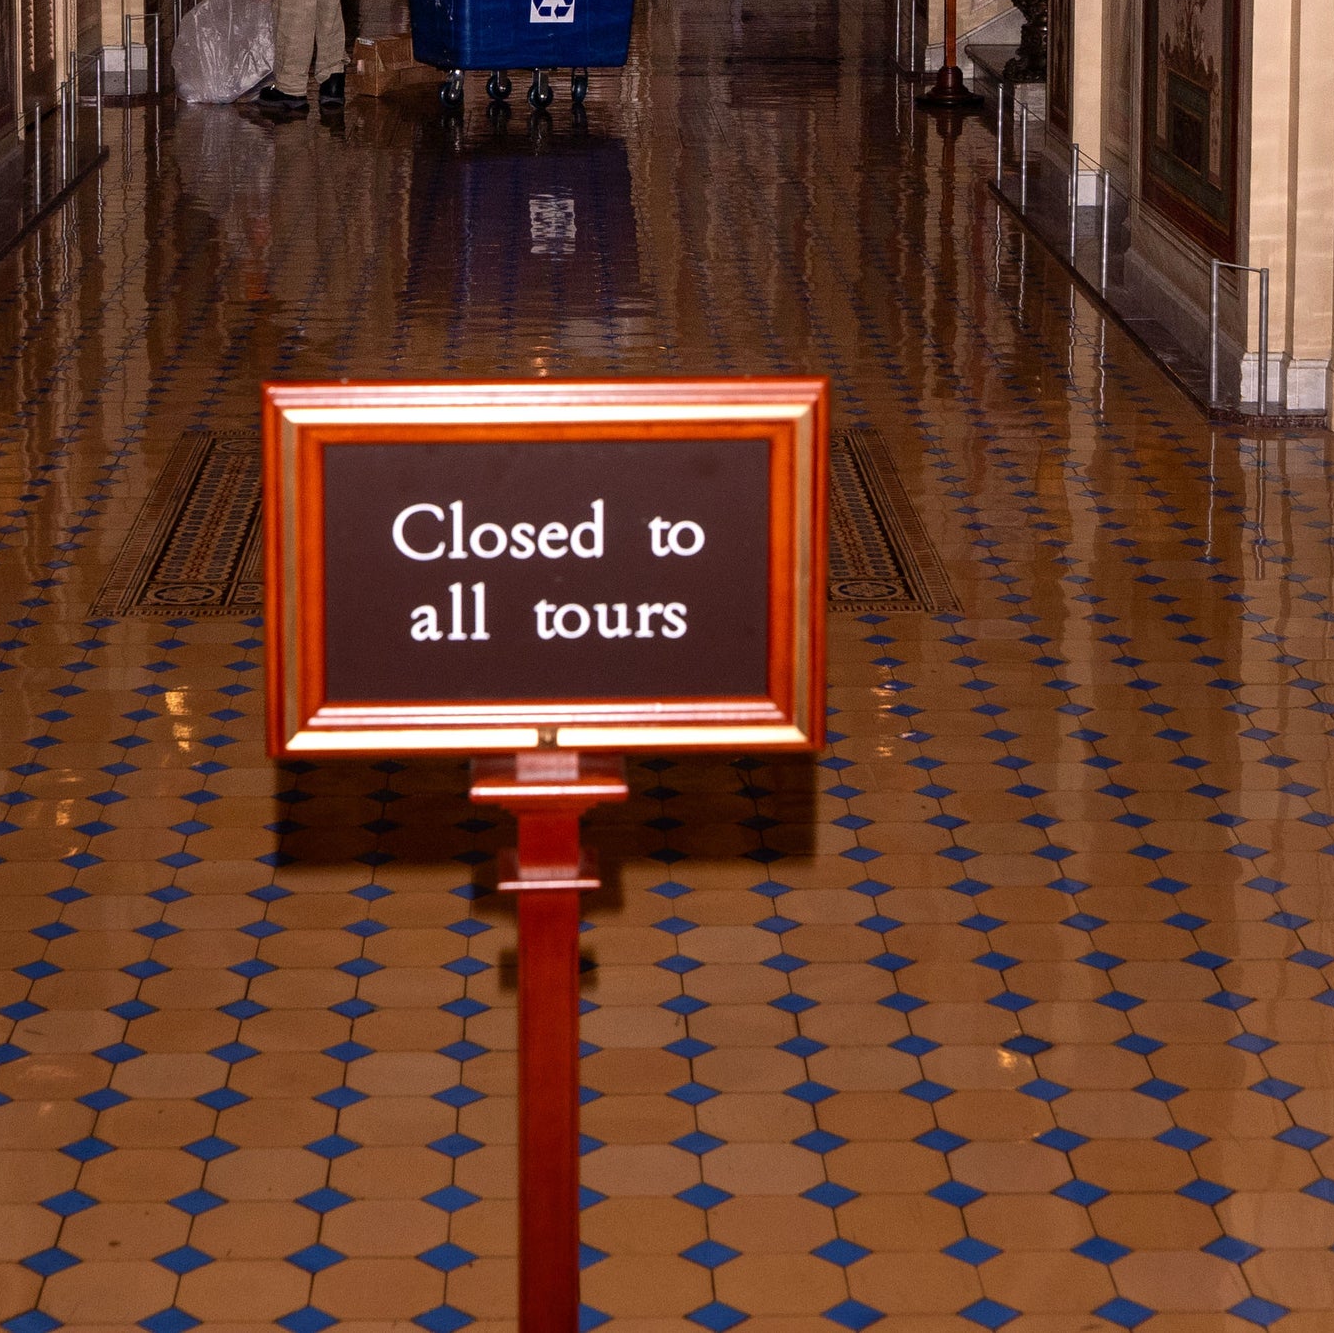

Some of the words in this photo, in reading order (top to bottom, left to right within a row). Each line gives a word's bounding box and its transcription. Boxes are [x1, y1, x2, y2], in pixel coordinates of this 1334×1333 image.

[391, 498, 605, 560] Closed
[648, 515, 705, 557] to
[410, 581, 490, 641] all
[534, 598, 687, 639] tours
